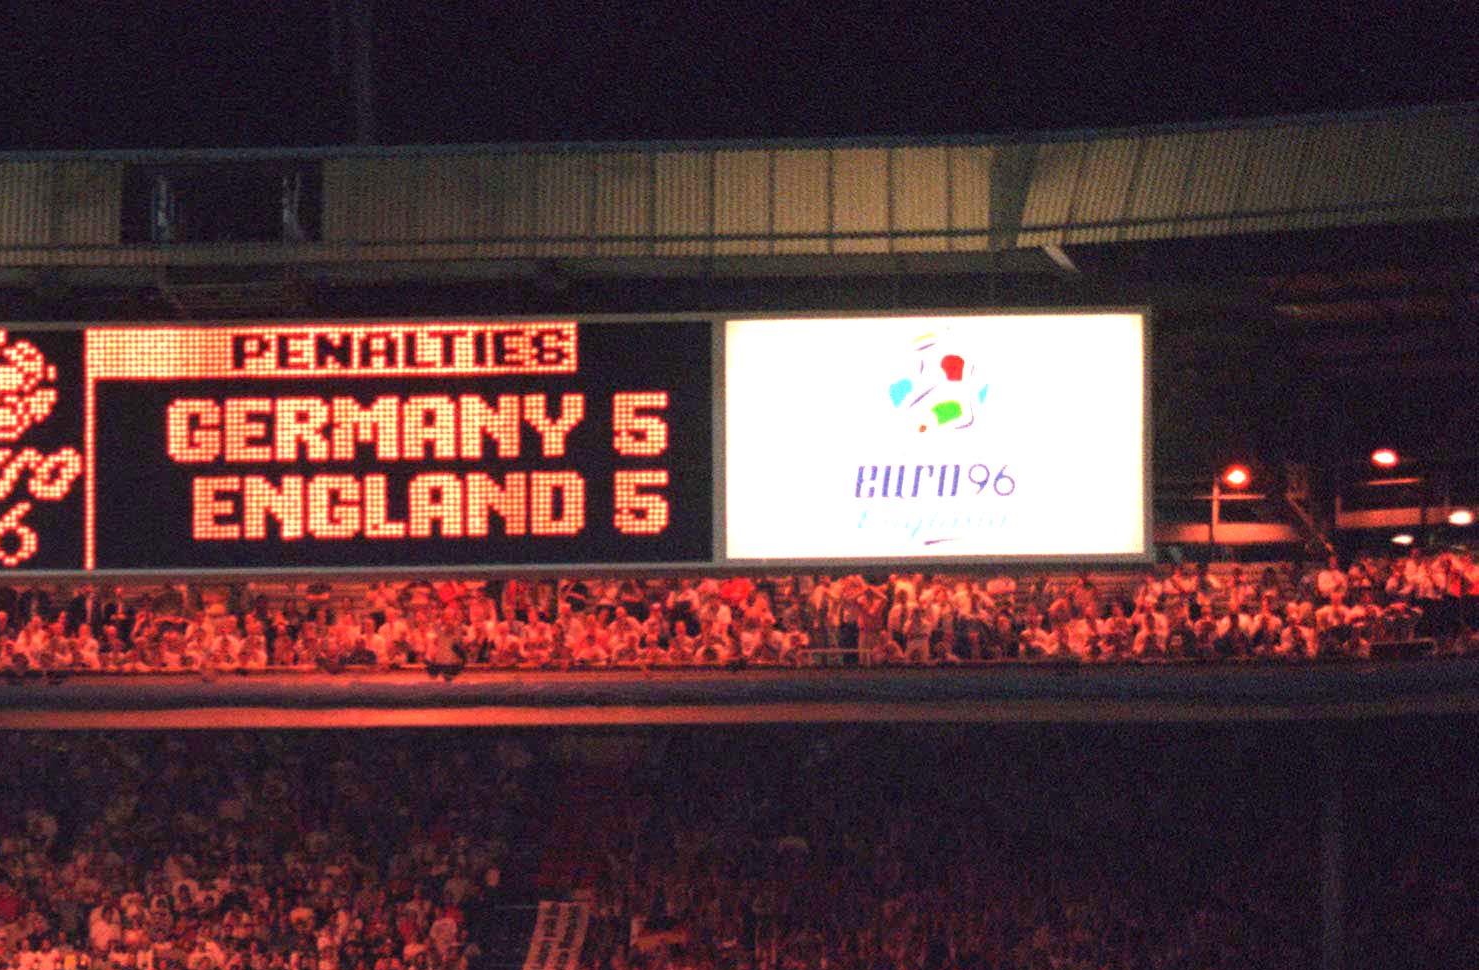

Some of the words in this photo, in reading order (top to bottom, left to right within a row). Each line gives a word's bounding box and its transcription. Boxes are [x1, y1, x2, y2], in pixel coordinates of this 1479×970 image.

[232, 329, 571, 370] PENALTIES
[167, 392, 585, 463] GERMANY
[613, 391, 668, 457] 5
[192, 470, 585, 541] ENGLAND
[613, 470, 668, 536] 5
